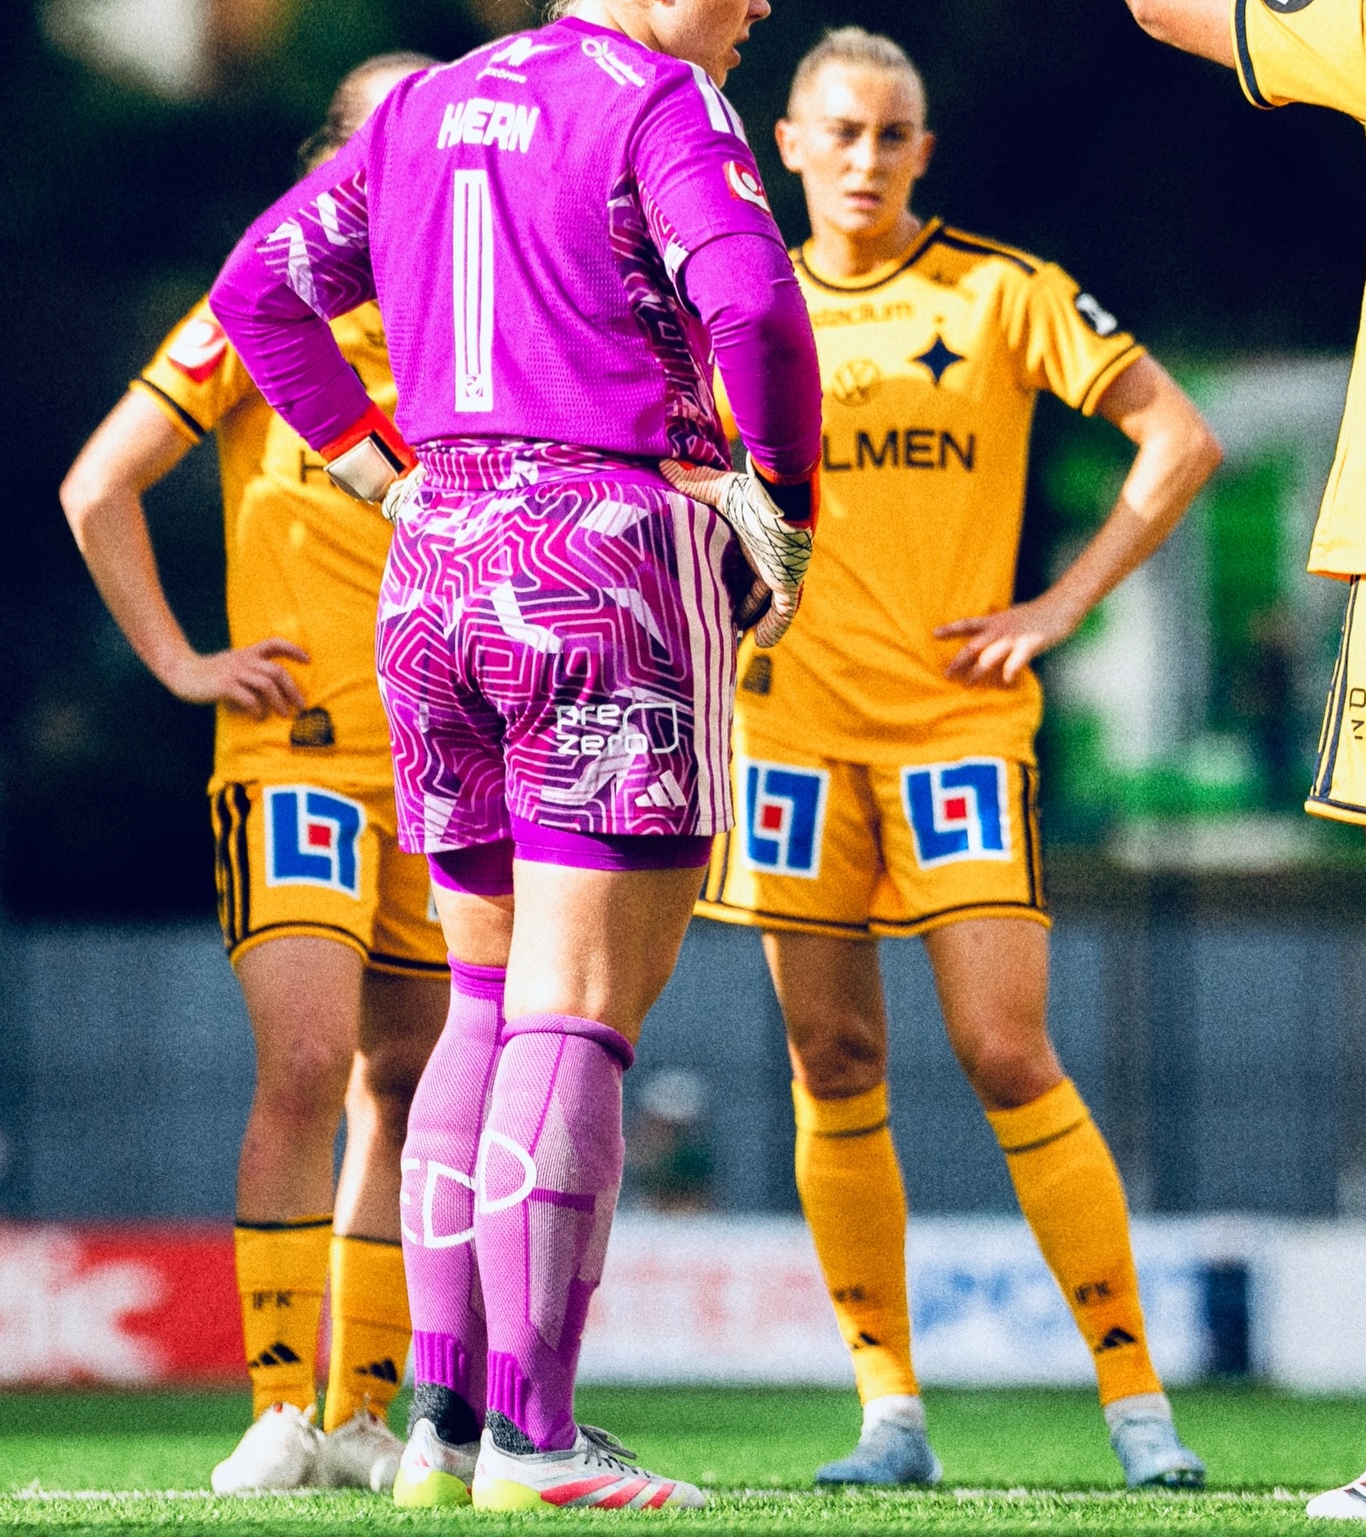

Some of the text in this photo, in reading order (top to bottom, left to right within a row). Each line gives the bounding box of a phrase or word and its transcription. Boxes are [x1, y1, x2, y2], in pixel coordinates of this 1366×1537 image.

[452, 169, 494, 412] 1
[822, 428, 975, 473] LMEN
[556, 704, 621, 732] pre
[556, 733, 649, 756] zero
